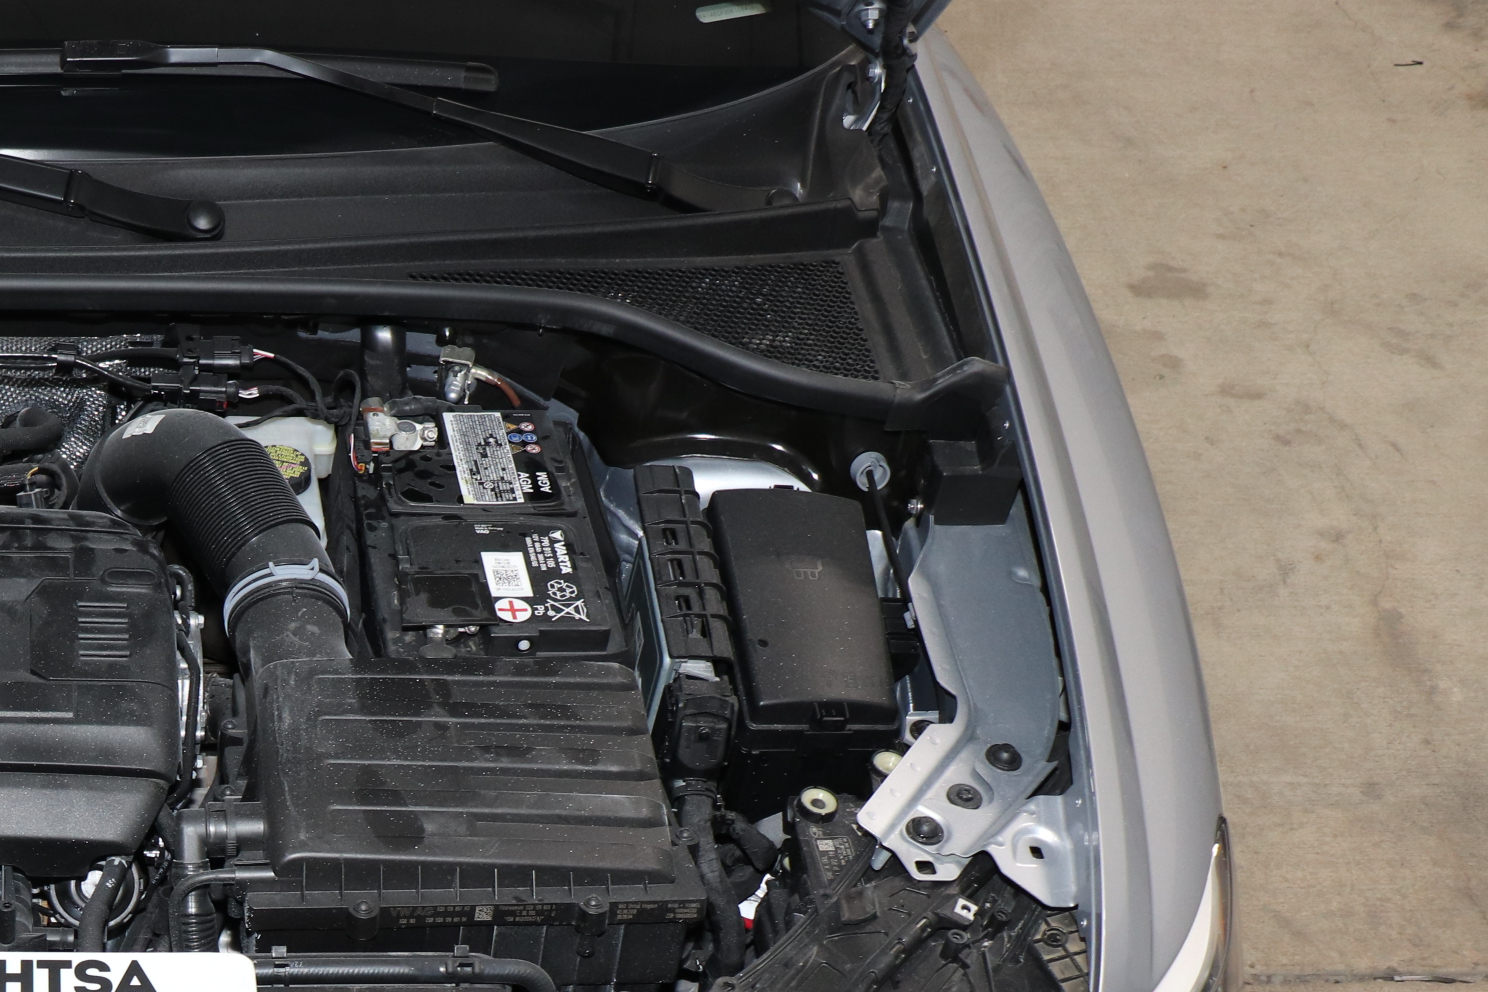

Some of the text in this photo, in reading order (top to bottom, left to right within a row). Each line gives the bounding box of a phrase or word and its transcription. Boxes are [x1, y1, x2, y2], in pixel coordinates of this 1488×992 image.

[517, 471, 534, 493] AGM
[535, 471, 553, 493] AGM
[553, 542, 573, 575] VARTA
[533, 605, 545, 616] Pb
[390, 907, 412, 916] VW
